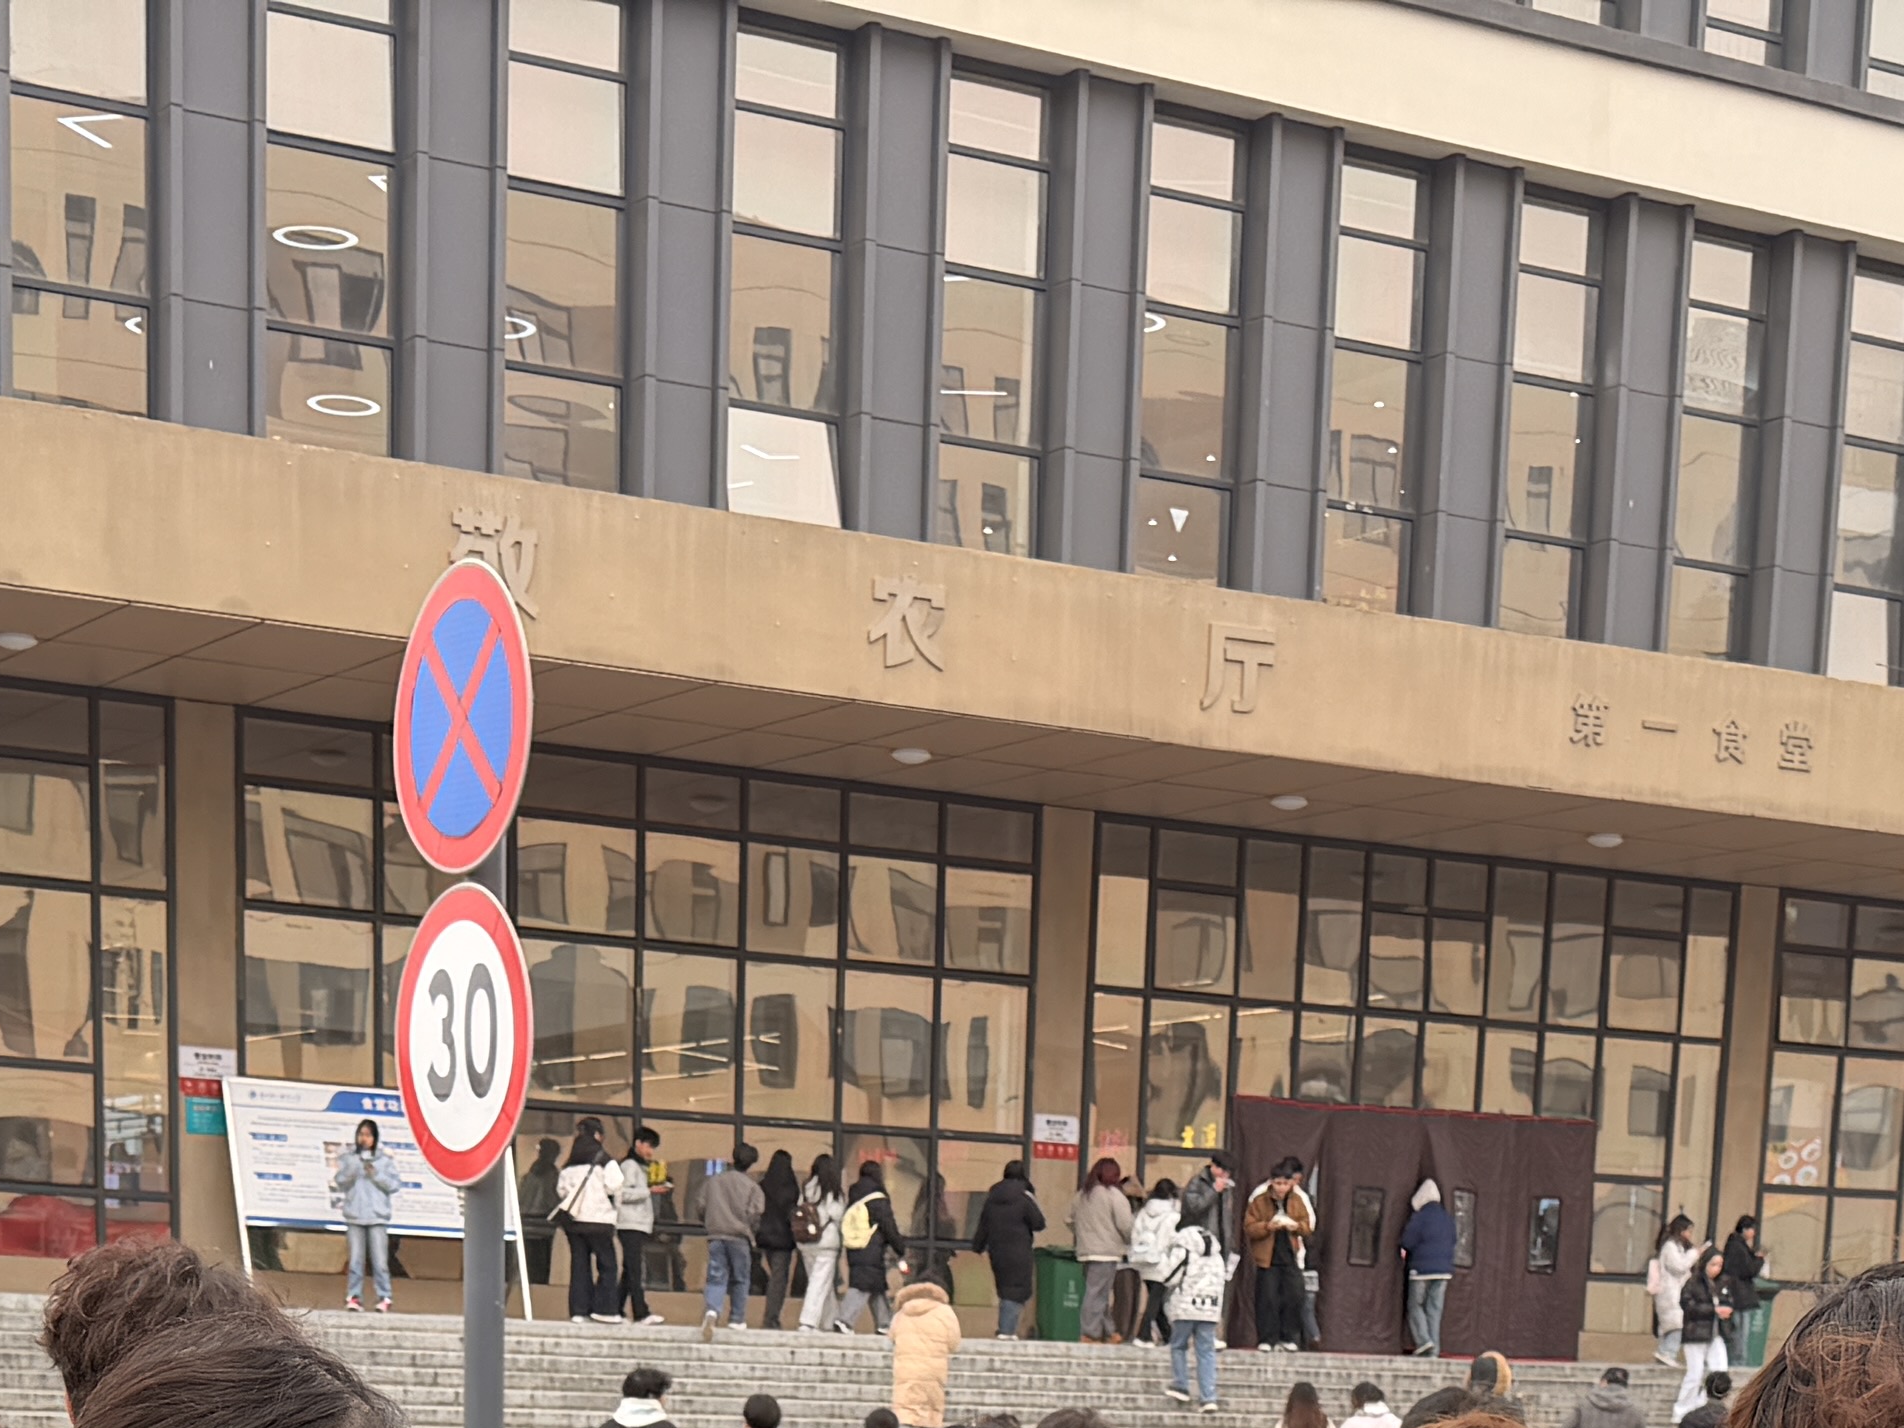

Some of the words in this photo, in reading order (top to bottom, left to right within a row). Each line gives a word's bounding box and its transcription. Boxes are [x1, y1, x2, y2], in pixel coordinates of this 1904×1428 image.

[1569, 693, 1814, 774] 第一食堂
[427, 962, 498, 1103] 30
